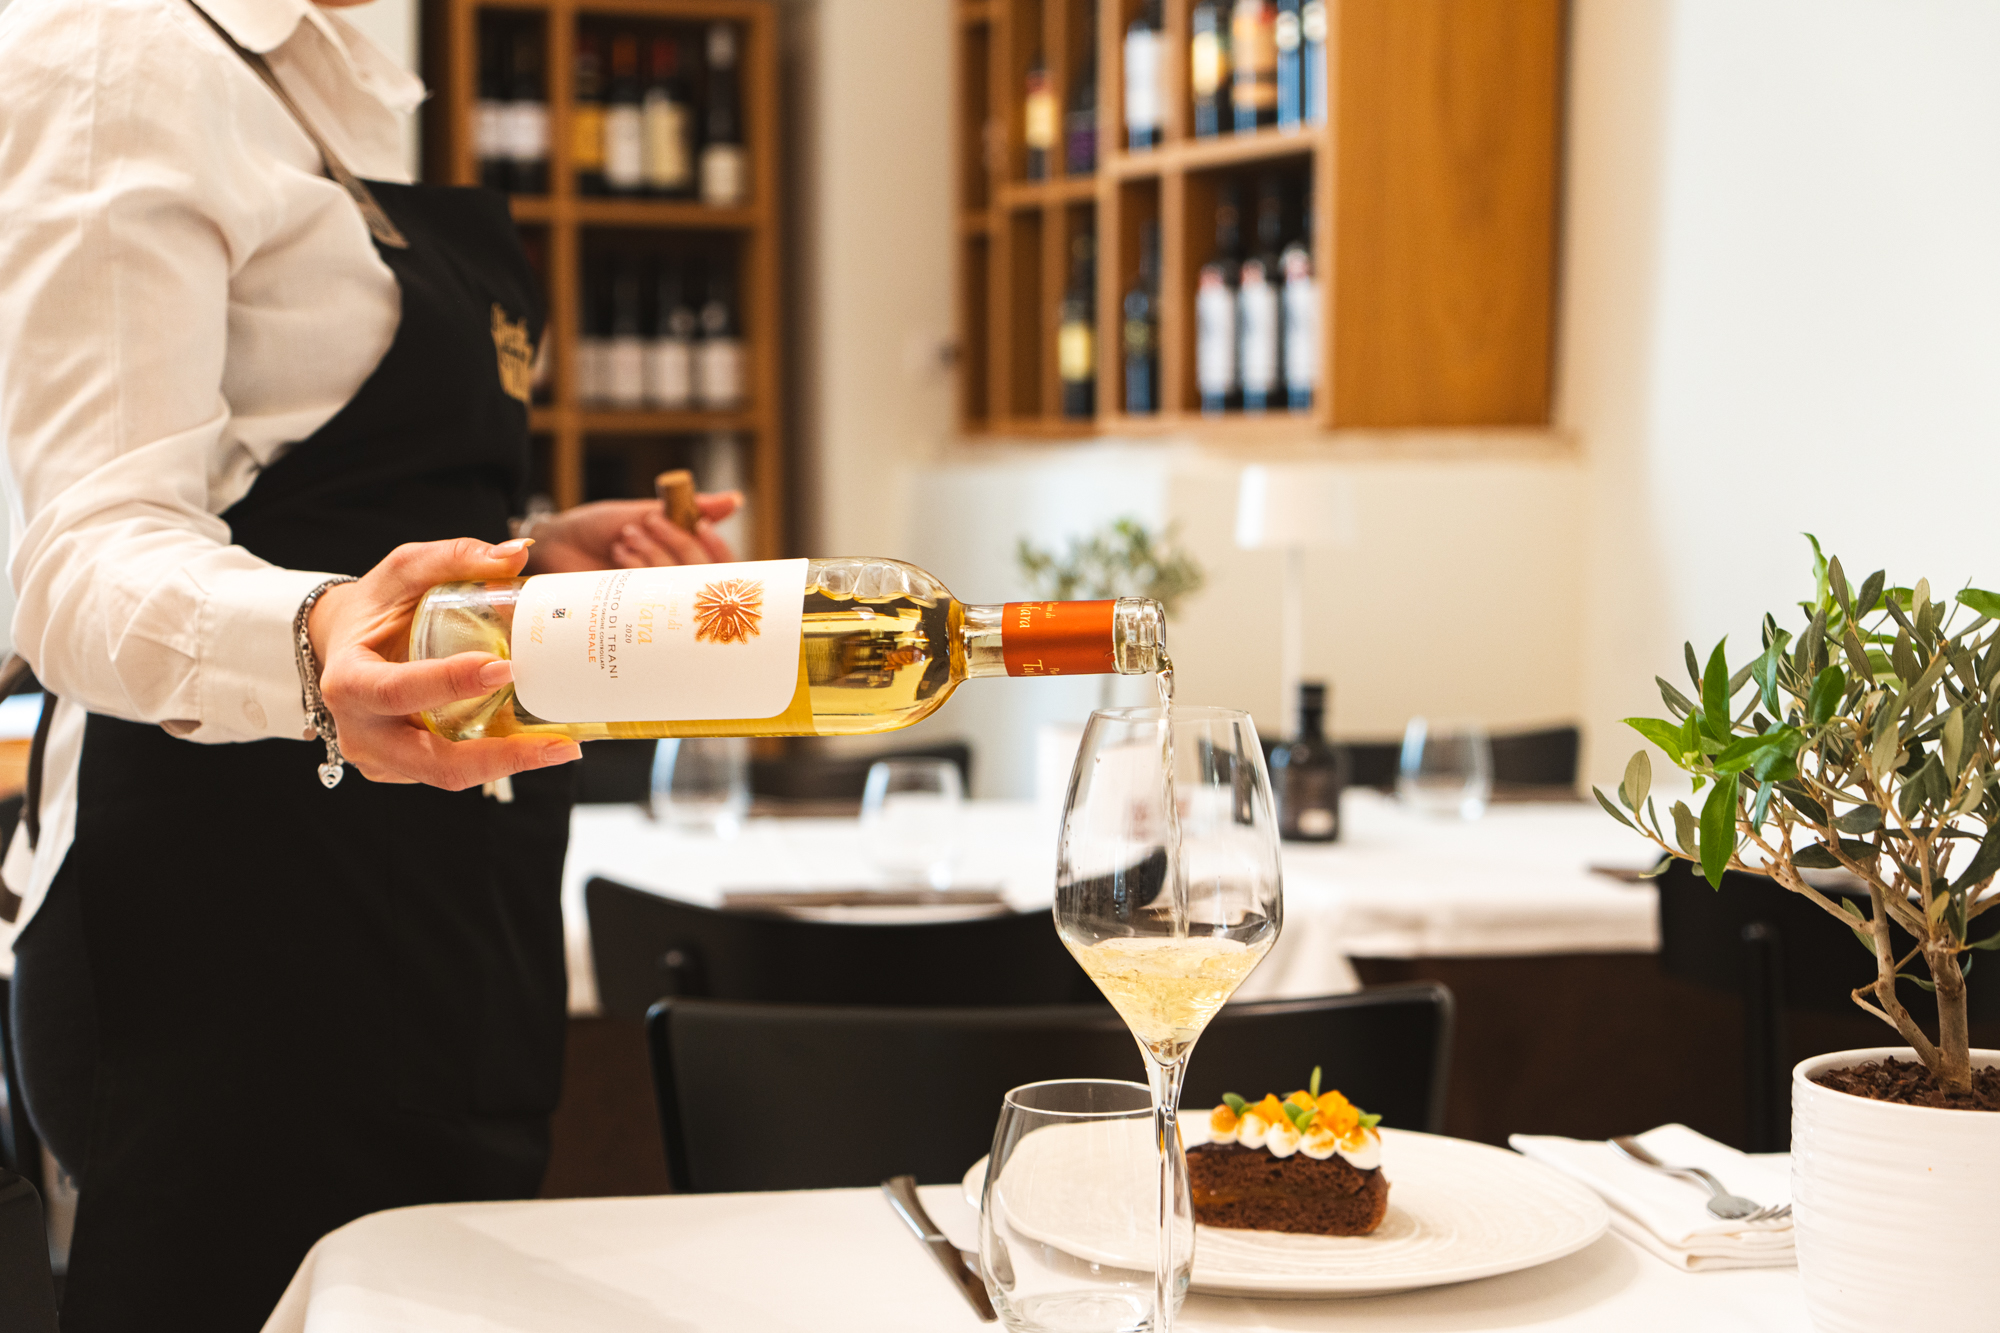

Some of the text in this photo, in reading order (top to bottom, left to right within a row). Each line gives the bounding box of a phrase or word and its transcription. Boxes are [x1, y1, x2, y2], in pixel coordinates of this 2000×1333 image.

[608, 615, 618, 628] DI
[634, 579, 673, 645] Tufara
[667, 618, 683, 630] di
[1016, 602, 1043, 628] ufara
[588, 604, 599, 663] NATURALE
[625, 623, 633, 644] 2020
[608, 634, 618, 679] TRANI
